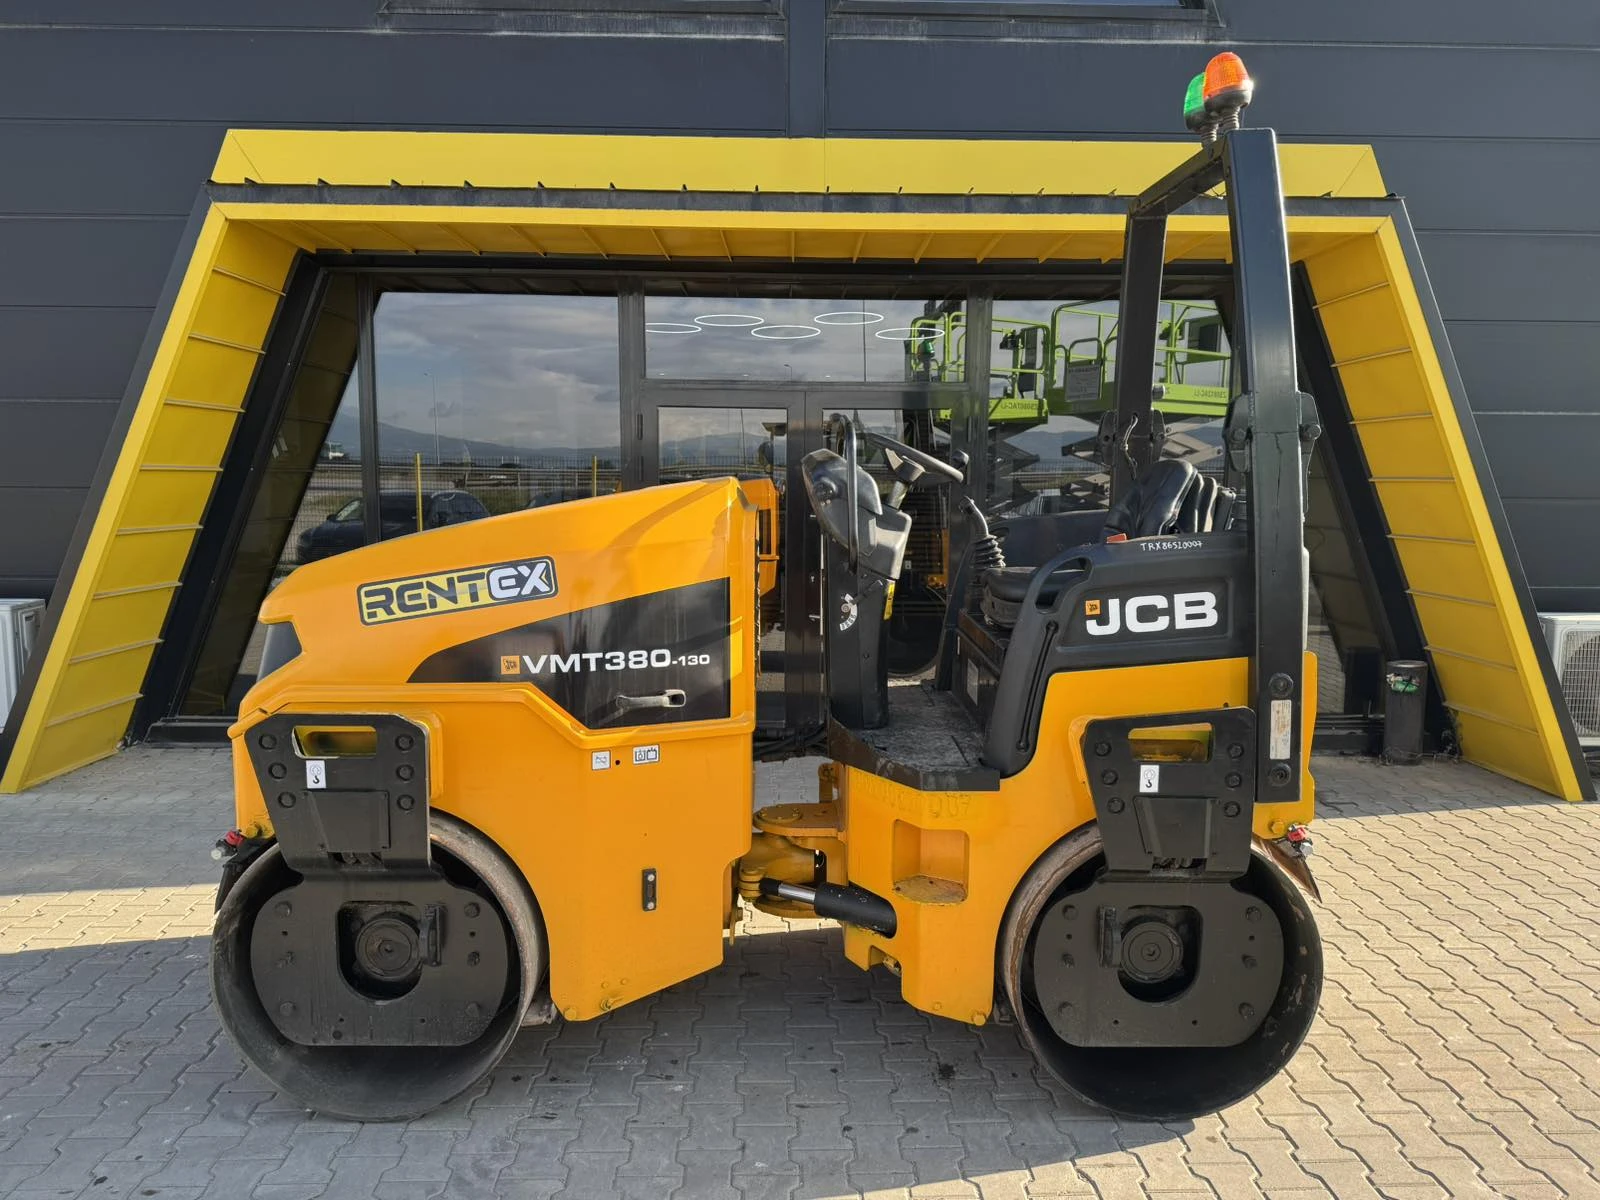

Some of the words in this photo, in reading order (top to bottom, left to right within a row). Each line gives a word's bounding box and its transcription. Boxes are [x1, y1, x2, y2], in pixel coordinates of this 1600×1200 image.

[363, 561, 550, 620] RENTEX
[1085, 591, 1219, 636] JCB
[522, 649, 711, 674] VMT380-130
